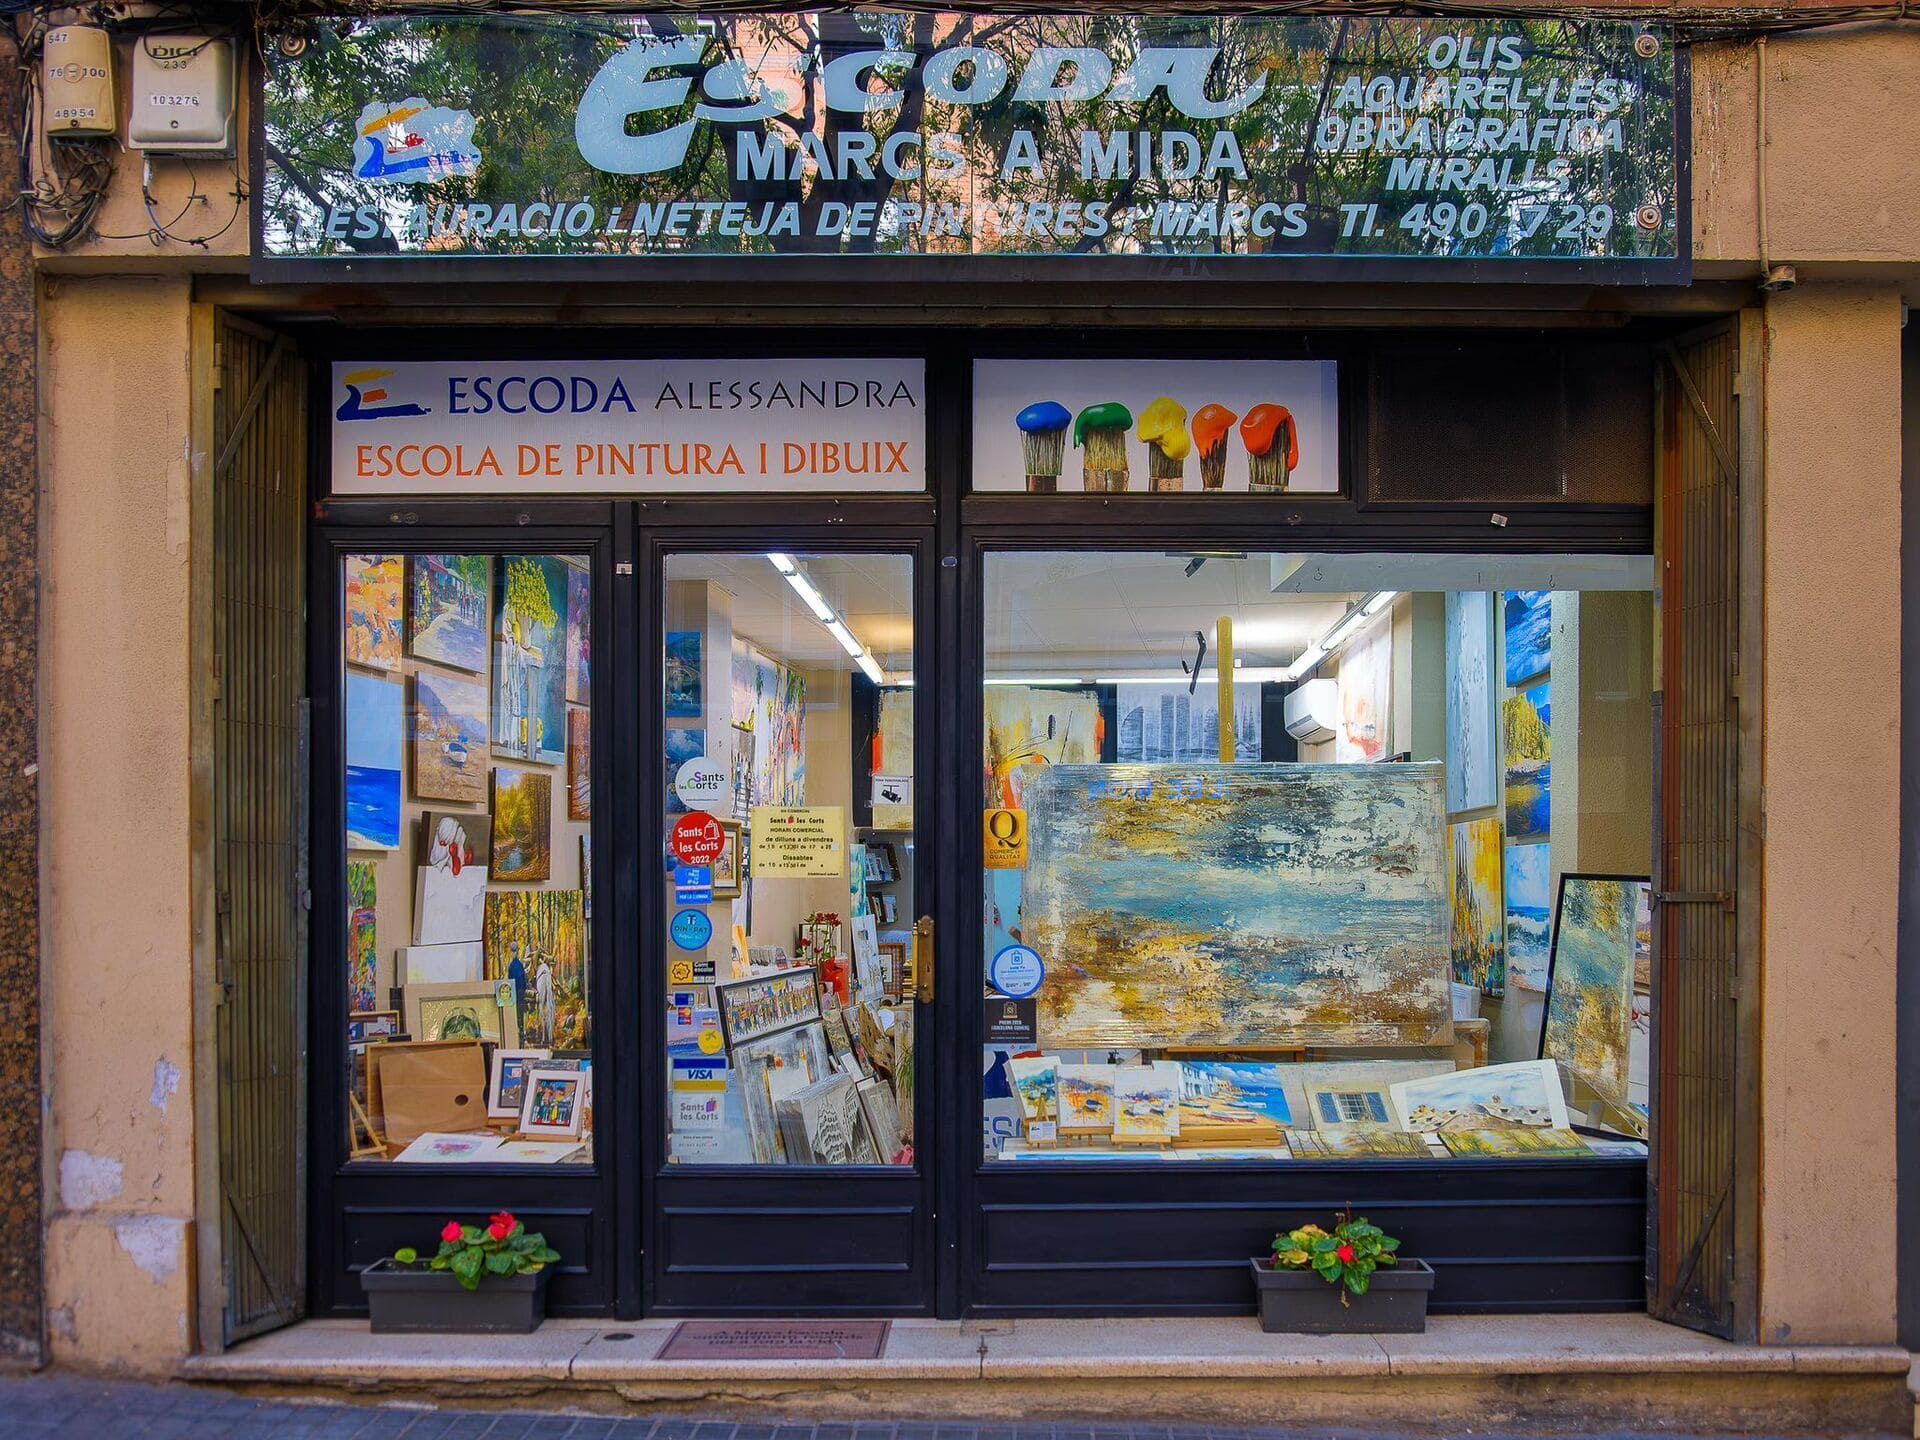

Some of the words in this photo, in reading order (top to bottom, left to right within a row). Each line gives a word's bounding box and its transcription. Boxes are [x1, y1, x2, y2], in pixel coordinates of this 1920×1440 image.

[1427, 35, 1524, 72] OLIS
[163, 60, 188, 70] 233
[152, 95, 200, 106] 103276
[1332, 75, 1620, 113] AQUAREL-LES
[55, 108, 95, 118] 48954
[1316, 116, 1432, 151] OBRA
[736, 130, 965, 182] MARCS
[1001, 130, 1045, 181] A
[1081, 130, 1249, 181] MIDA
[1385, 157, 1571, 193] MIRALLS
[630, 201, 801, 237] NETEJA
[815, 201, 878, 237] DE
[1151, 201, 1308, 238] MARCS
[1399, 201, 1488, 239] 490
[1555, 202, 1614, 240] 29
[448, 375, 637, 415] ESCODA
[654, 379, 918, 410] ALESSANDRA
[356, 443, 504, 478] ESCOLA
[517, 443, 564, 477] DE
[575, 442, 746, 477] PINTURA
[759, 442, 768, 475] I
[783, 441, 911, 475] DIBUIX
[694, 771, 725, 782] Sants
[687, 778, 719, 790] Corts
[677, 827, 703, 838] Sants
[989, 810, 1022, 848] Q
[679, 841, 693, 853] les
[694, 840, 719, 852] Corts
[690, 855, 711, 865] 2022
[688, 1069, 713, 1080] VISA
[680, 1102, 705, 1111] Sants
[680, 1112, 692, 1121] les
[695, 1111, 719, 1121] Corts
